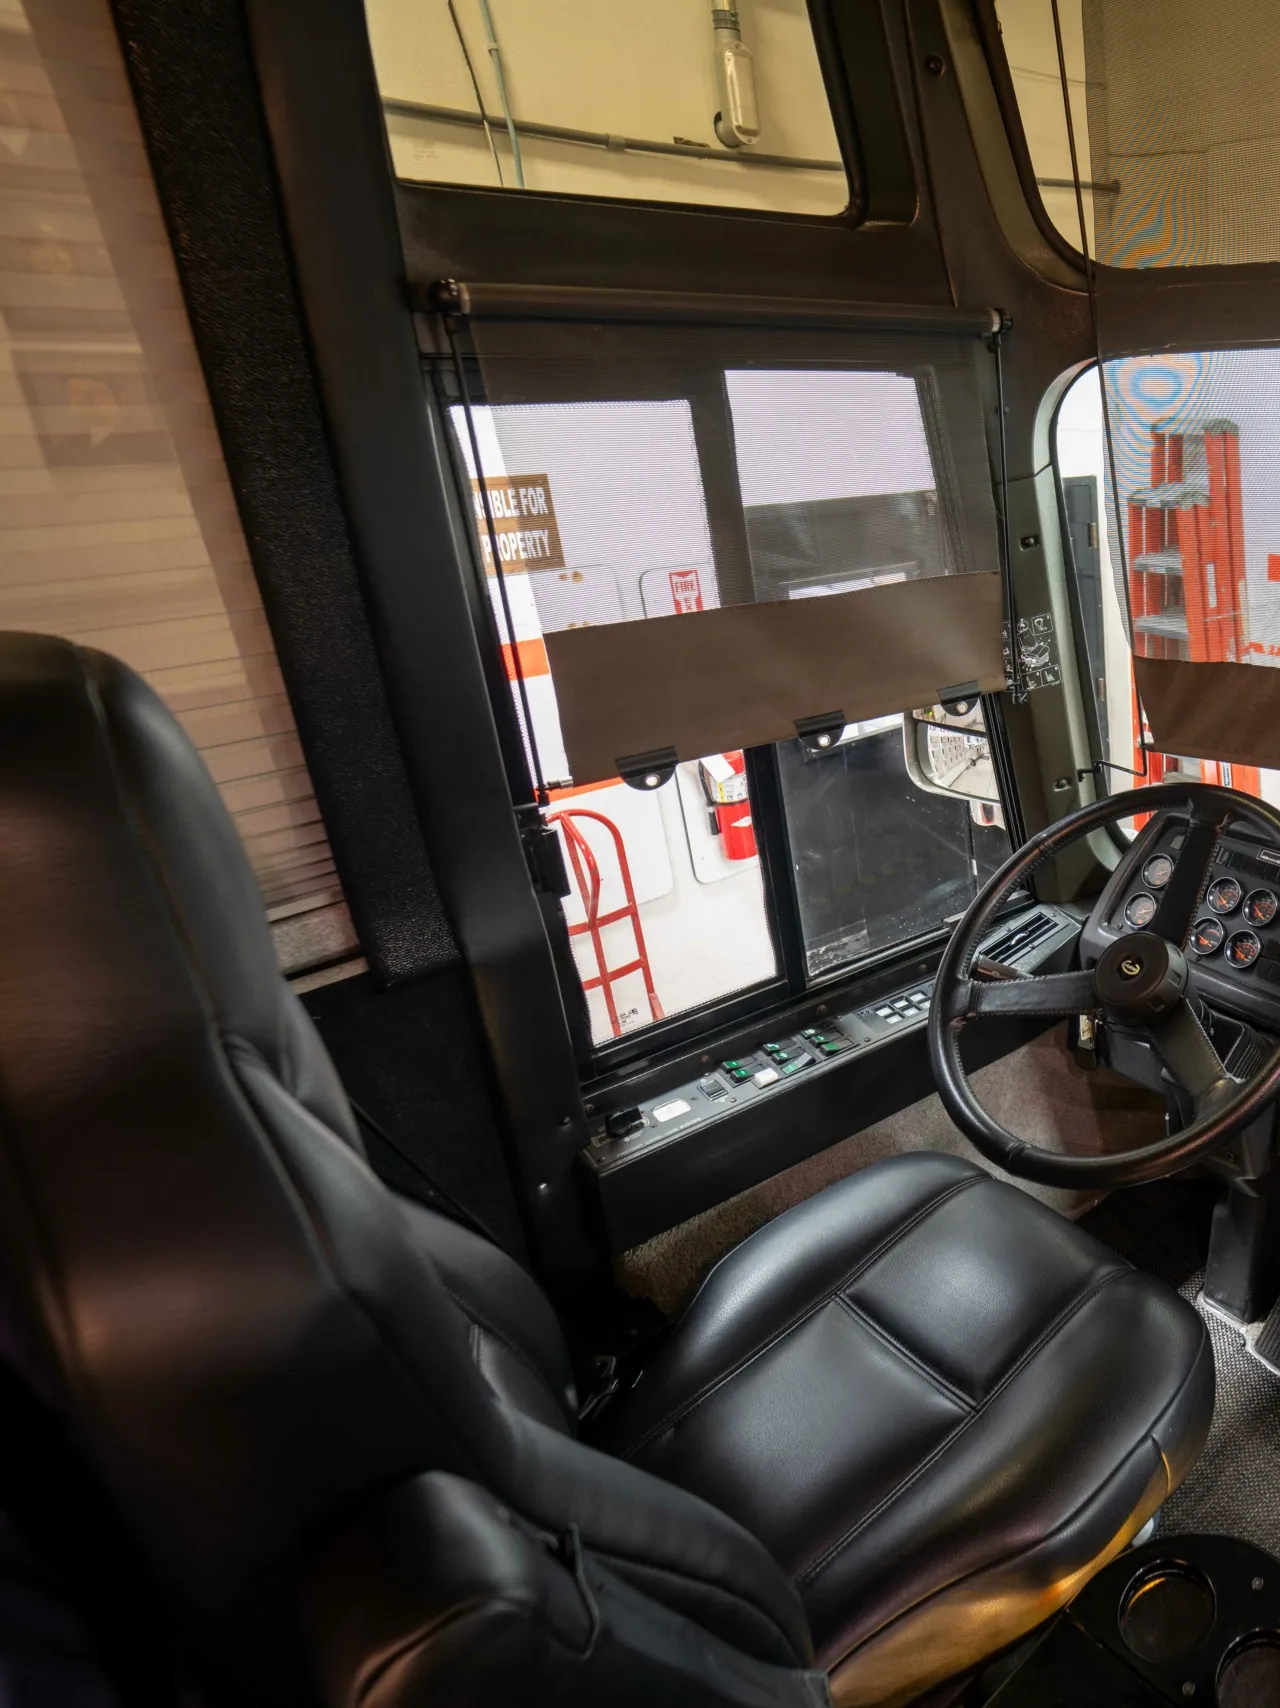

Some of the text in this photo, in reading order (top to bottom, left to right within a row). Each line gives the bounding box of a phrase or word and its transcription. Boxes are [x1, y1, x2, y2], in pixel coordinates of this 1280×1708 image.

[519, 487, 549, 516] FOR
[481, 529, 550, 563] POPERTY
[674, 580, 696, 593] FIRE
